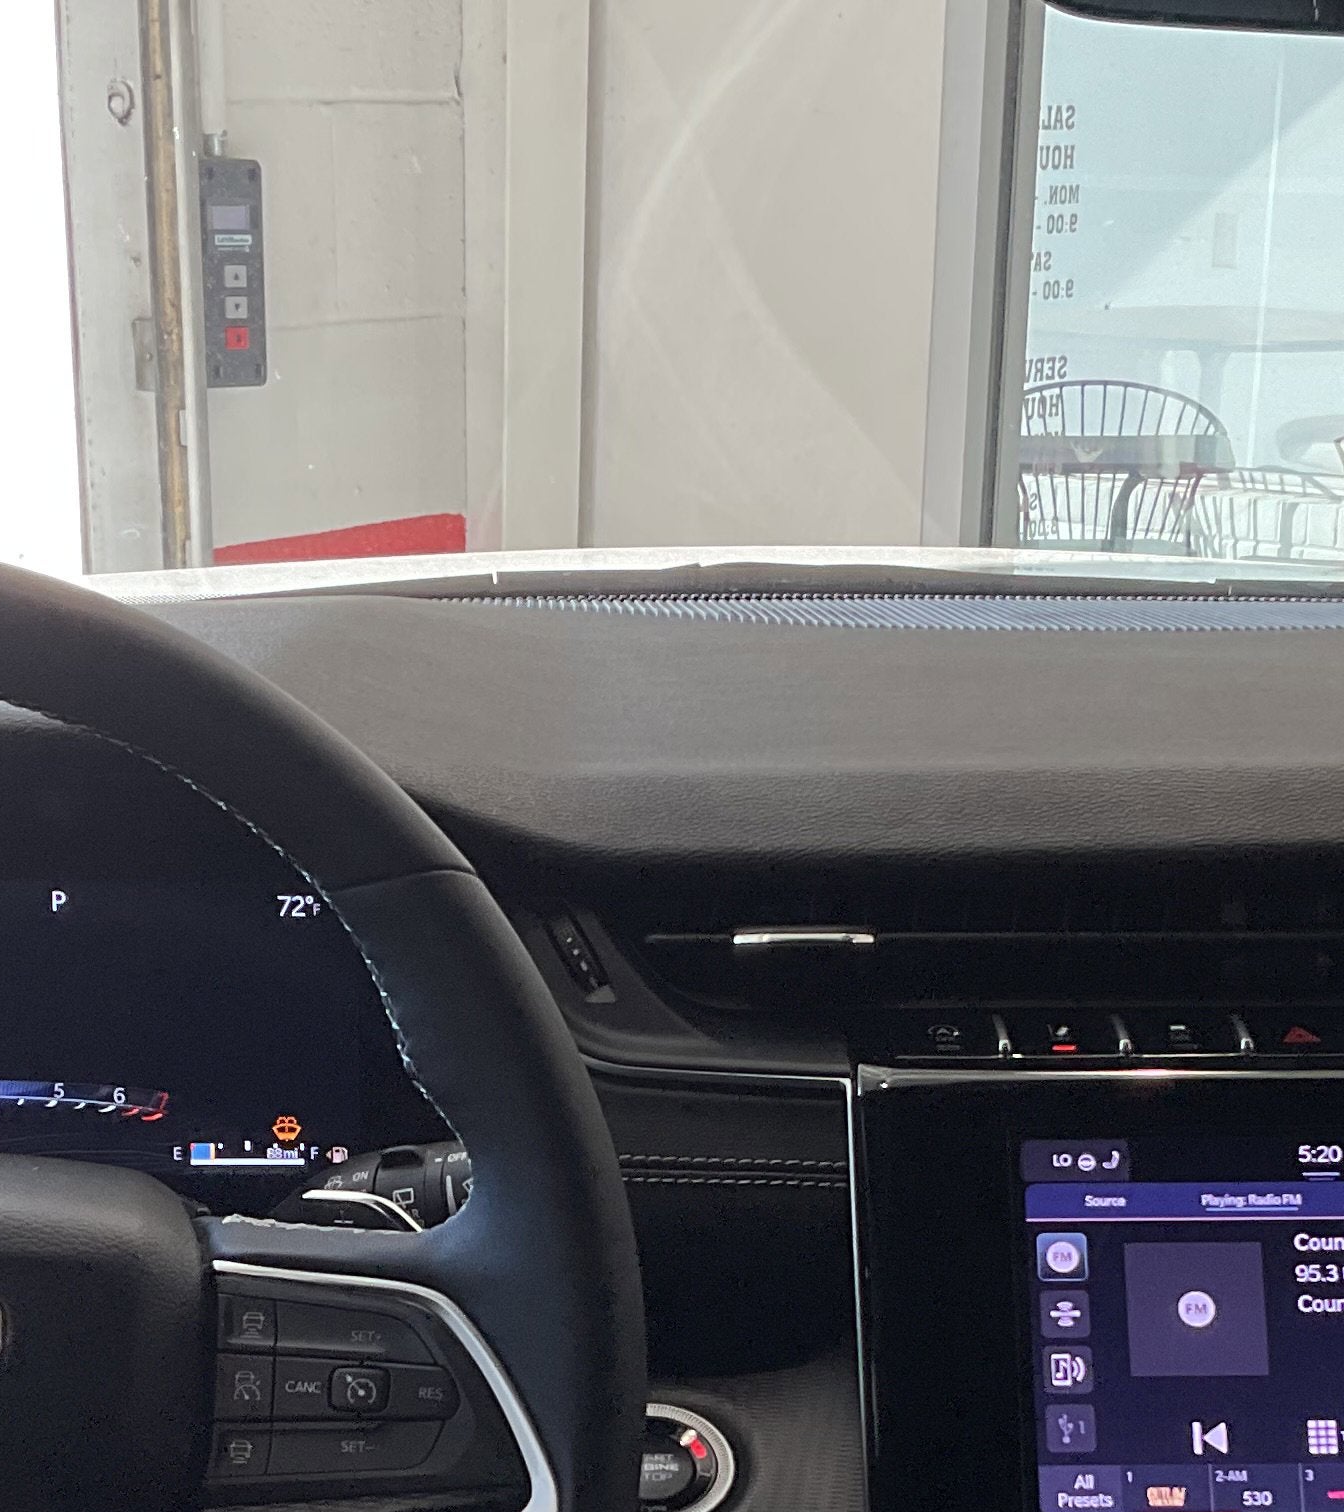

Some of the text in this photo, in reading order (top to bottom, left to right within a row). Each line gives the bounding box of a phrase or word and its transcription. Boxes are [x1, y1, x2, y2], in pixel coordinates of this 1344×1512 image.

[51, 890, 67, 912] P
[54, 1082, 65, 1098] 5
[113, 1087, 126, 1105] 6
[173, 1146, 183, 1161] E
[309, 1146, 319, 1161] F
[1052, 1154, 1073, 1168] LO
[1298, 1145, 1343, 1164] 5:20
[1084, 1194, 1127, 1208] Source
[1294, 1264, 1339, 1283] 95.3
[1184, 1303, 1207, 1316] FM
[1074, 1473, 1095, 1490] All
[1215, 1470, 1248, 1483] 2-AM
[1305, 1469, 1315, 1481] 3
[1057, 1492, 1114, 1509] Presets
[1242, 1490, 1273, 1507] 530
